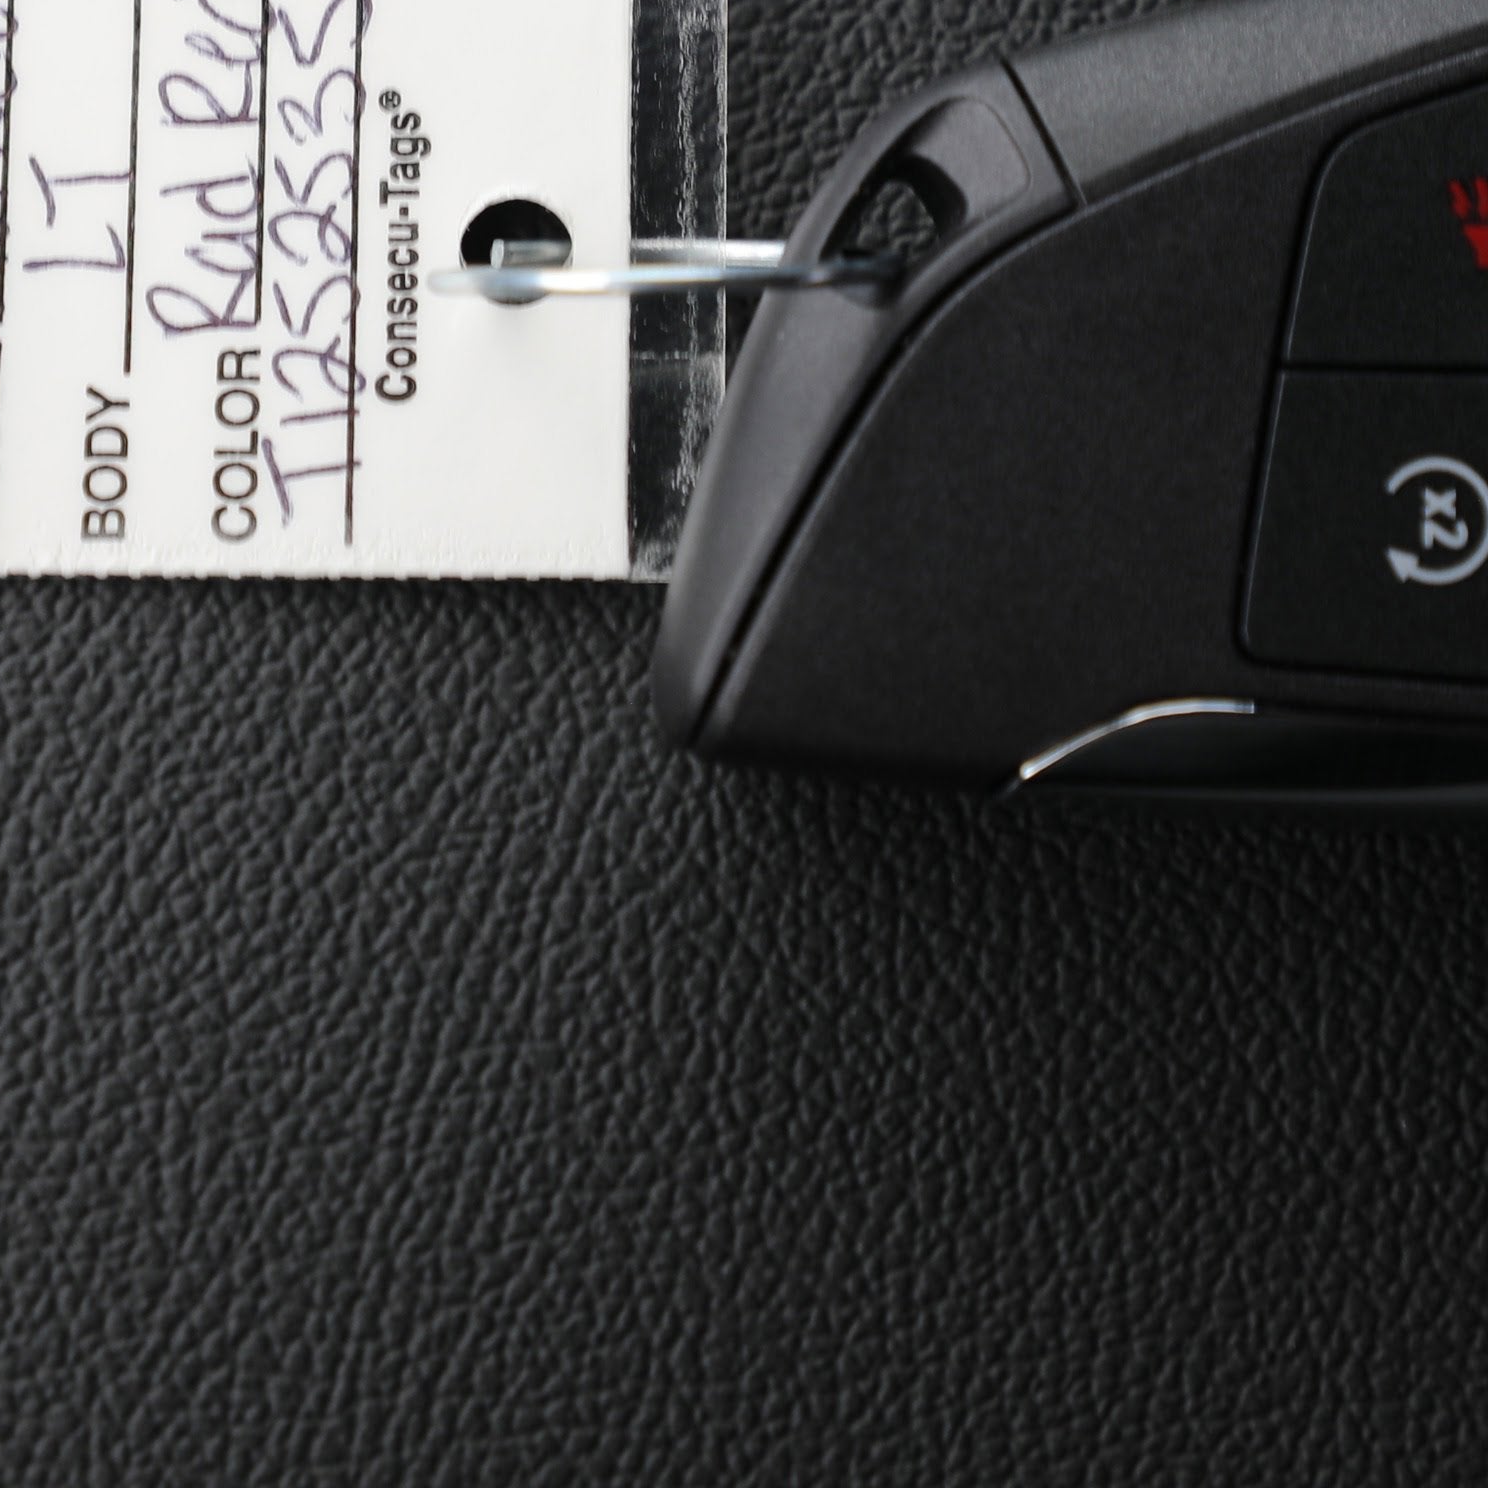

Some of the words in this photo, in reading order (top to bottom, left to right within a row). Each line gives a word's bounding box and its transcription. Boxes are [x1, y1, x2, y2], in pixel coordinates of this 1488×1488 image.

[22, 155, 132, 272] LT
[80, 385, 131, 542] BODY
[211, 347, 262, 543] COLOR
